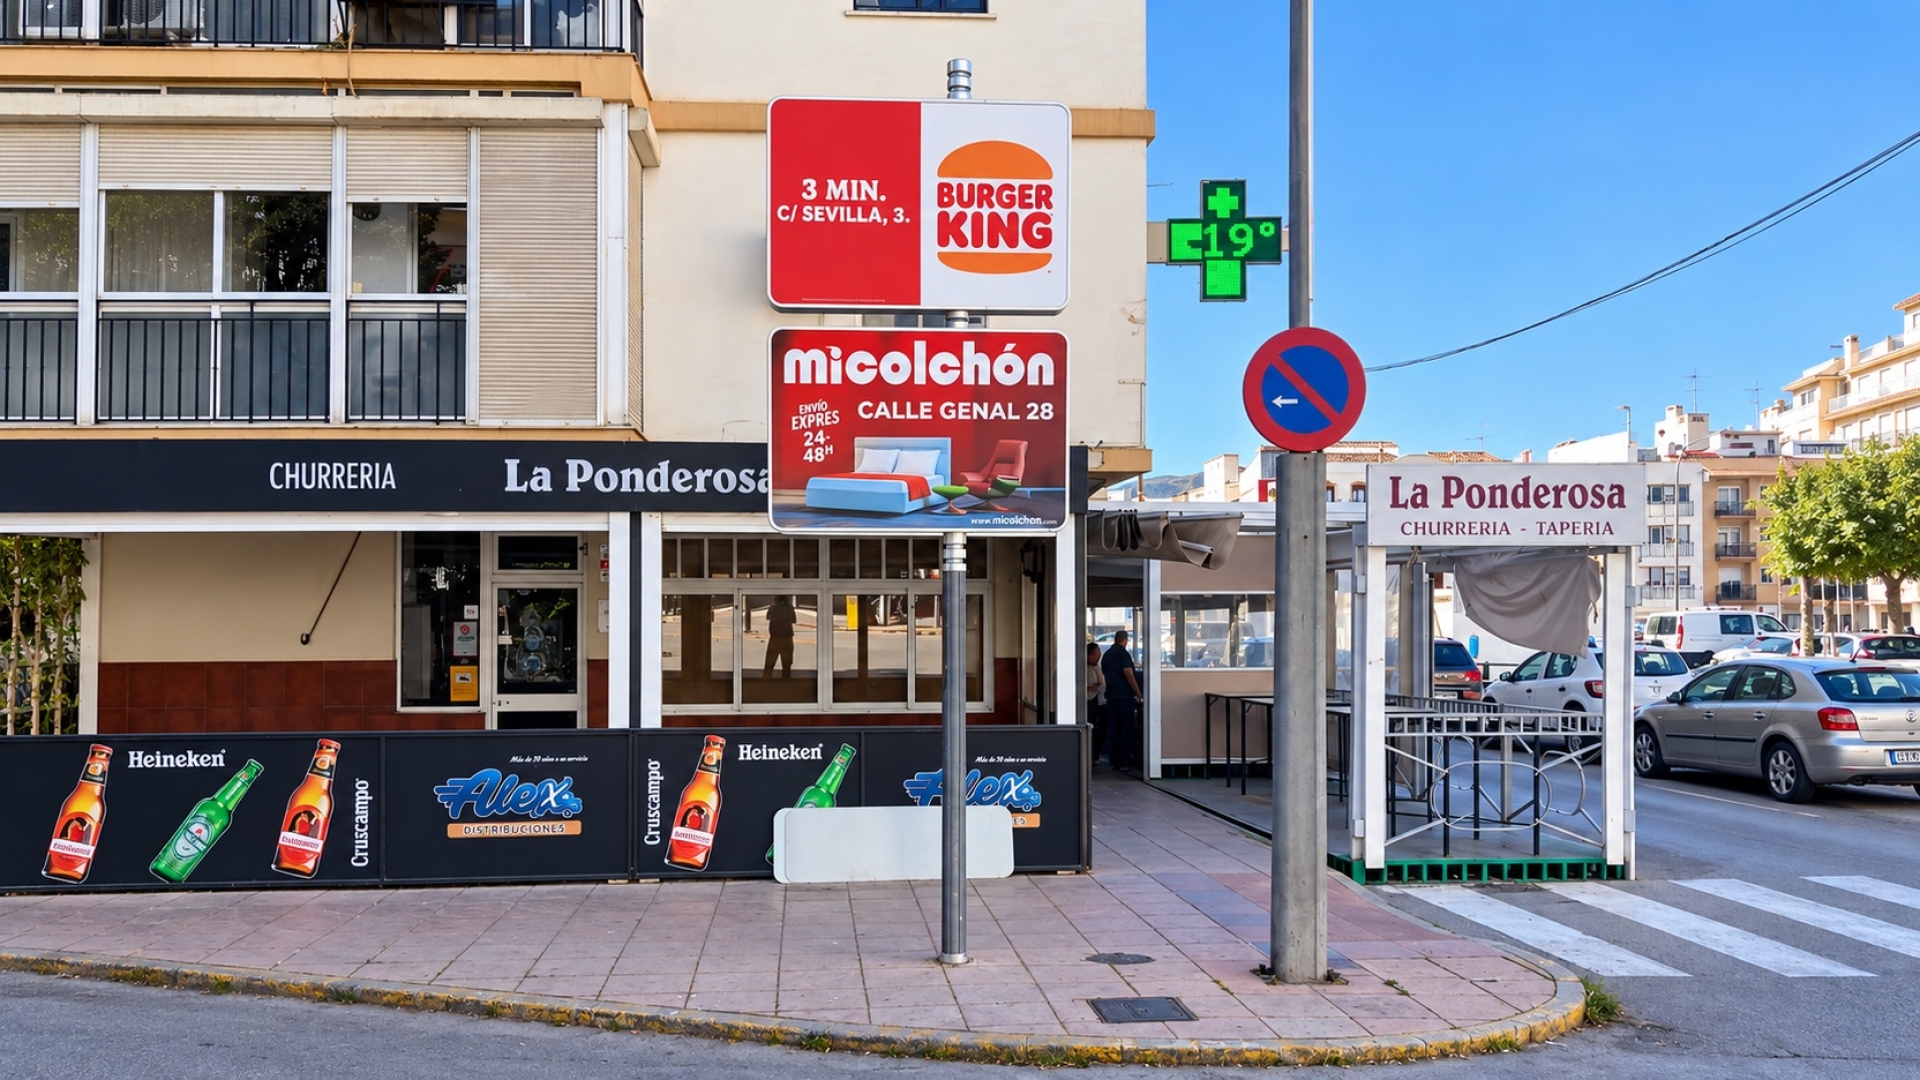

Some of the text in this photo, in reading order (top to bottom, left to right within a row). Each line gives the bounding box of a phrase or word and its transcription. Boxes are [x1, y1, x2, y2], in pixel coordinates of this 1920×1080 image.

[802, 178, 887, 202] 3 MIN.
[937, 182, 1053, 209] BURGER
[776, 204, 911, 226] C/ SEVILLA, 3.
[937, 211, 1053, 249] KING
[783, 340, 1055, 386] micolchón
[799, 399, 828, 414] ENVÍO
[857, 401, 1054, 421] CALLE GENAL 28
[791, 410, 840, 430] EXPRES
[269, 463, 397, 490] CHURRERIA
[504, 458, 553, 493] La
[1389, 475, 1627, 510] La Ponderosa
[1400, 520, 1511, 536] CHURRERIA
[1535, 520, 1615, 536] TAPERIA
[128, 748, 225, 769] Heineken
[738, 743, 823, 761] Heineken
[433, 767, 583, 819] Alex
[643, 758, 665, 846] Cruscampo
[350, 778, 373, 867] Cruscampo
[463, 823, 566, 836] DISTRIBUCIONES
